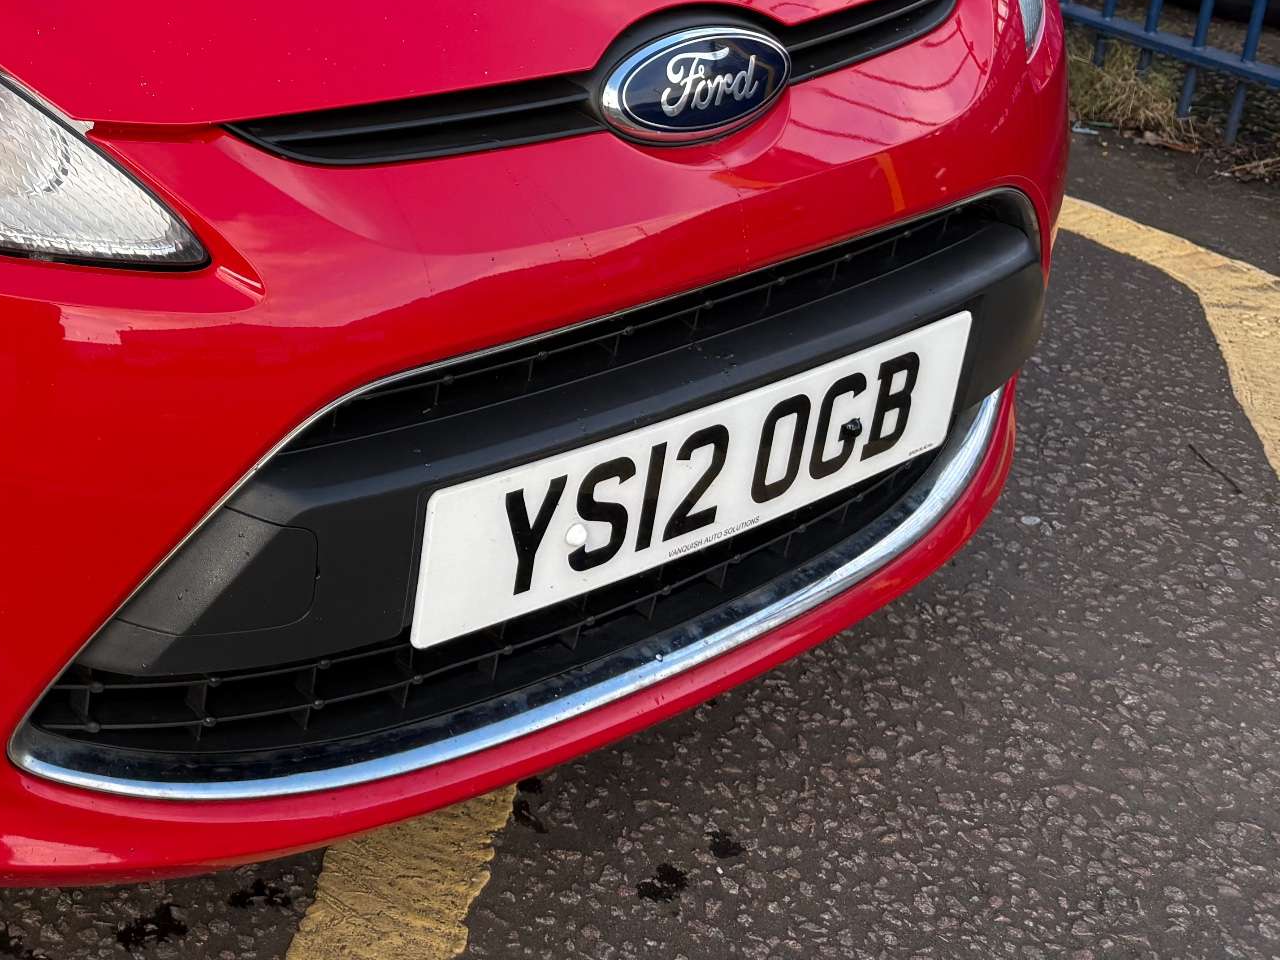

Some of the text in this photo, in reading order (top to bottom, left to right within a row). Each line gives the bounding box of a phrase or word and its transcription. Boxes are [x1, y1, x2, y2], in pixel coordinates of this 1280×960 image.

[661, 46, 759, 118] Ford
[505, 351, 921, 596] YS12 OGB
[668, 516, 760, 557] VANQUISH AUTO SOLUTIONS
